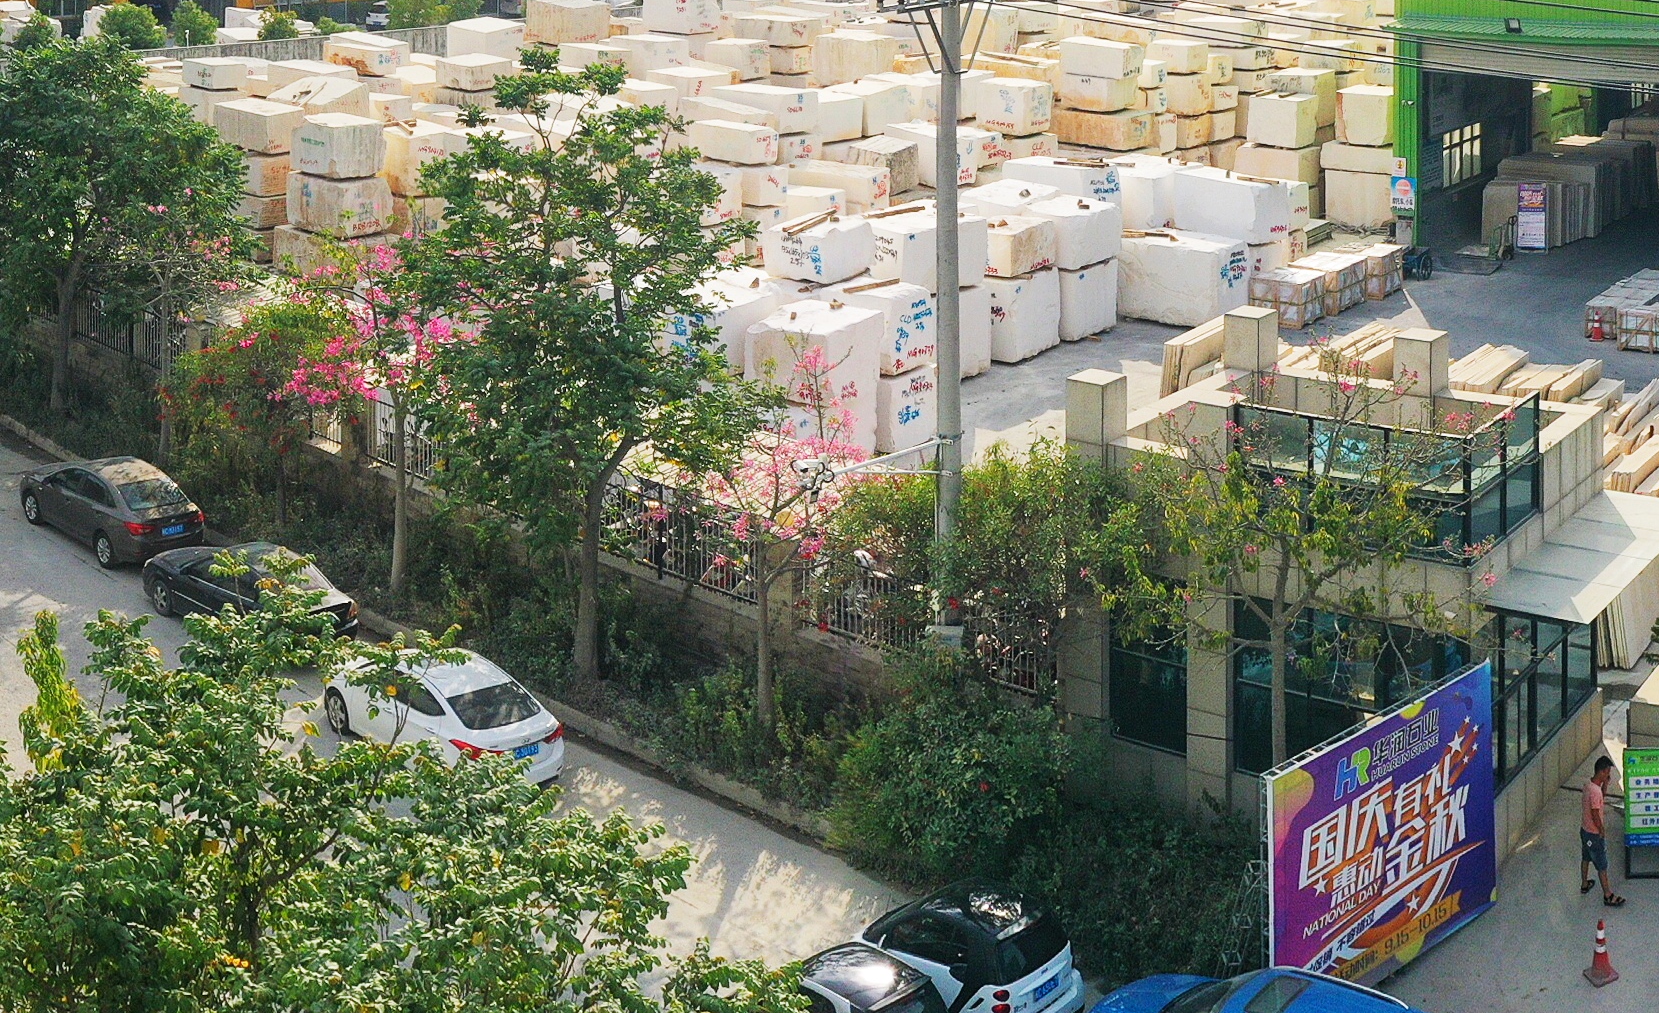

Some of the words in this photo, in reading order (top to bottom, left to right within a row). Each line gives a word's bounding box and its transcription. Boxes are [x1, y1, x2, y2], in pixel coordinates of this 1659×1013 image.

[1370, 751, 1411, 783] HUARUN
[1411, 733, 1440, 760] STONE
[1371, 707, 1440, 766] 华润石业
[1298, 754, 1453, 890] 国庆有礼
[1302, 897, 1357, 940] NATIONAL
[1357, 882, 1381, 906] DAY
